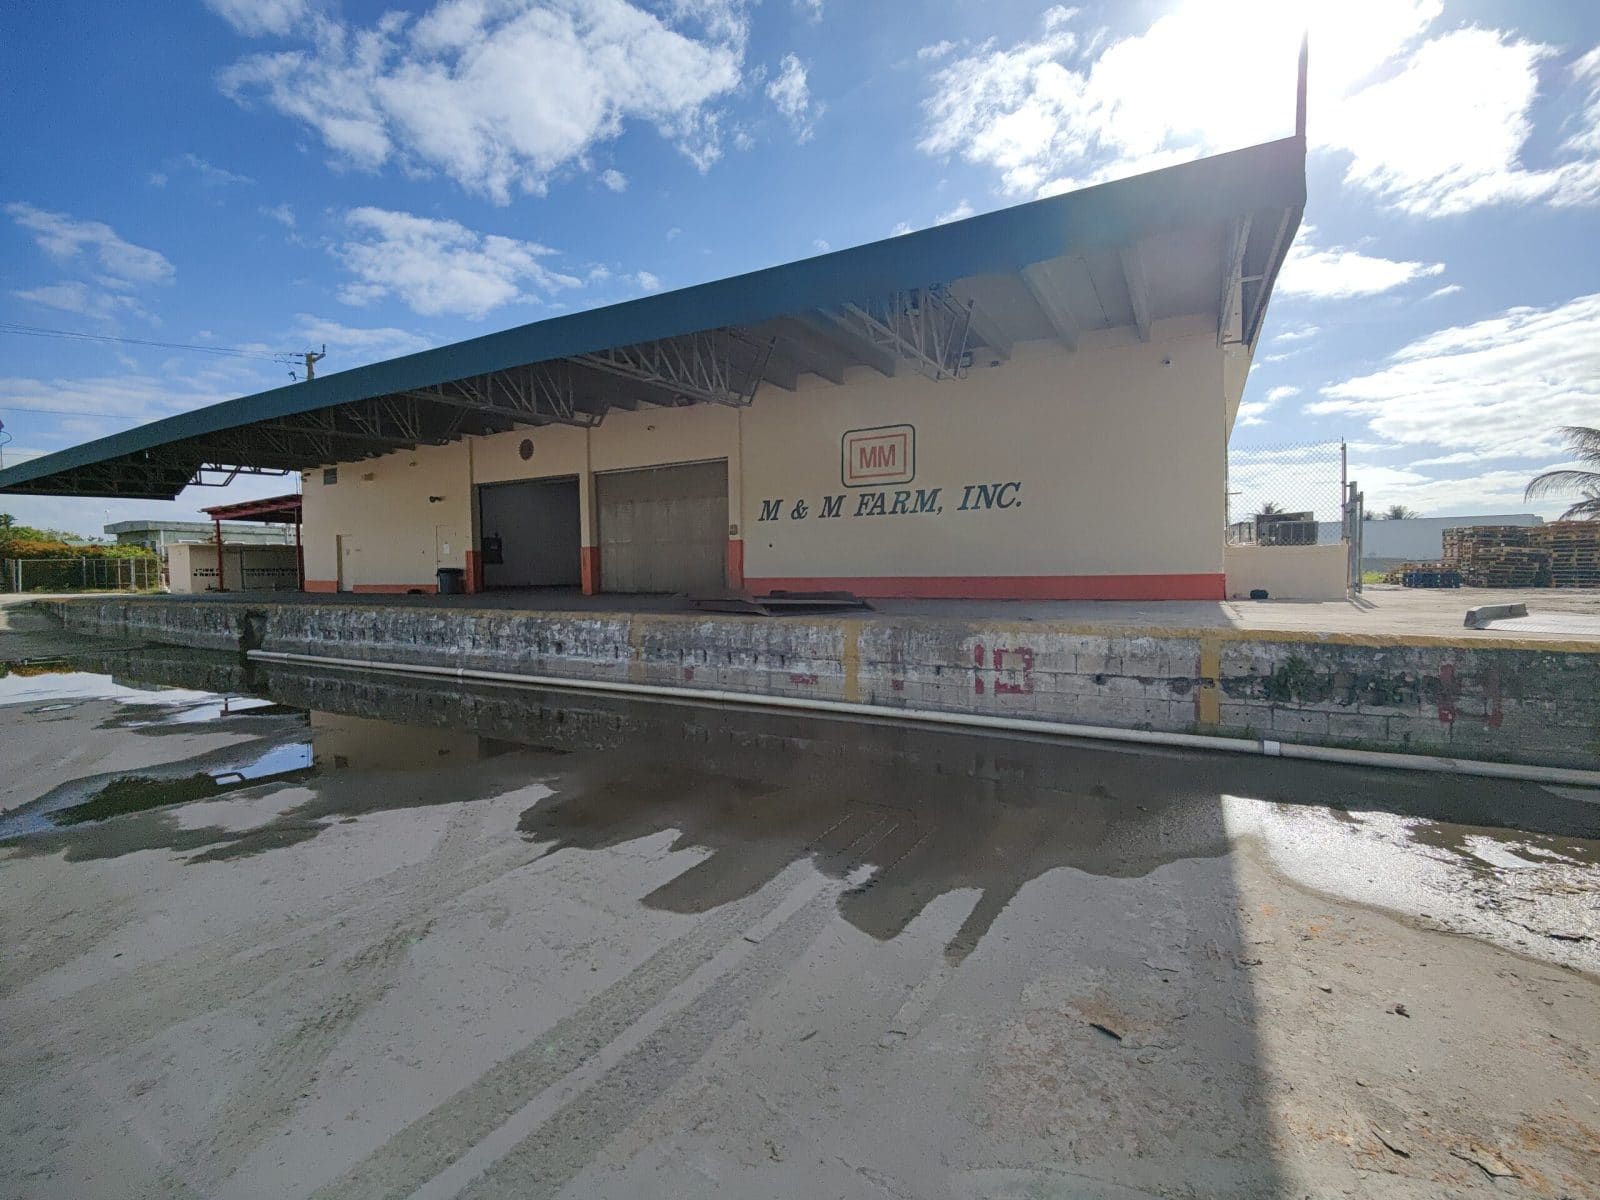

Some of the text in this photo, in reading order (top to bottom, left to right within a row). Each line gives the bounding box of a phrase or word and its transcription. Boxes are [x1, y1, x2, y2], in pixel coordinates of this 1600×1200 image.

[859, 444, 896, 469] MM
[758, 482, 1022, 521] M & M FARM, INC.
